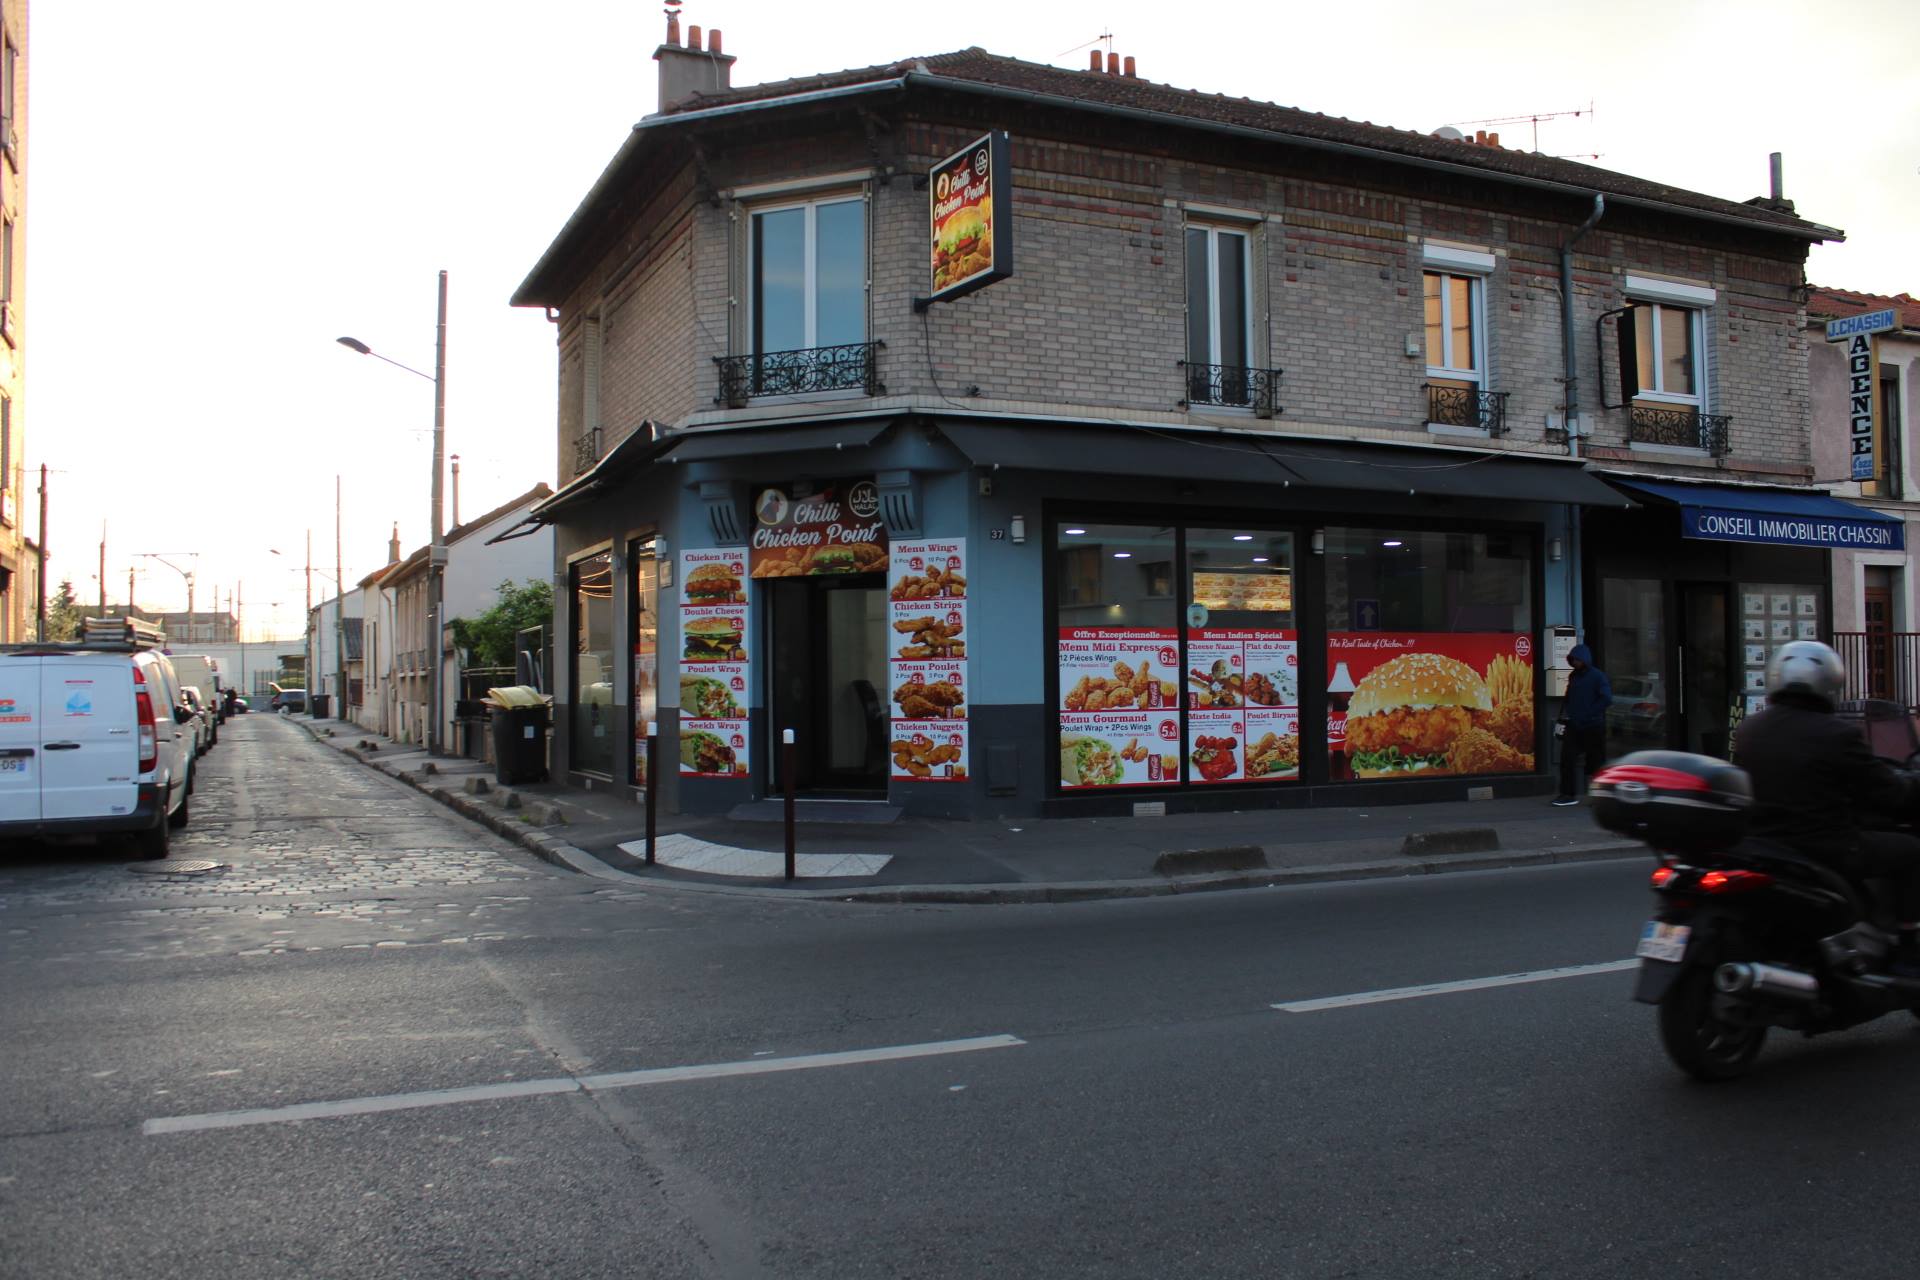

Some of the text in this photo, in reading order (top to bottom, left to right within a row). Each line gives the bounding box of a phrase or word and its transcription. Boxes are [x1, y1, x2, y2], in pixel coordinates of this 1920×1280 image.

[951, 168, 971, 194] Chilli
[934, 175, 989, 221] Chicken Point
[1827, 311, 1895, 337] J.CHASSIN
[1850, 335, 1872, 456] AGENCE
[794, 501, 841, 525] Chilli
[991, 529, 1004, 540] 37
[1698, 514, 1892, 545] CONSEIL IMMOBILIER CHASSIN
[753, 522, 884, 550] Chicken Point
[897, 543, 959, 554] Menu Wings
[685, 552, 744, 562] Chicken Filet
[684, 607, 744, 616] Double Cheese
[894, 601, 963, 611] Chicken Strips
[1073, 630, 1097, 640] Offre
[1098, 630, 1161, 641] Exceptionnelle
[1203, 632, 1283, 641] Menu Indien Spécial
[1059, 642, 1161, 654] Menu Midi Express
[1273, 643, 1291, 651] Jour
[1329, 638, 1342, 648] The
[1341, 638, 1355, 648] Real
[1355, 638, 1372, 648] Taste
[1372, 638, 1381, 650] of
[1059, 654, 1068, 662] 12
[1095, 653, 1118, 664] Wings
[687, 664, 742, 675] Poulet Wrap
[927, 662, 961, 672] Poulet
[1060, 713, 1147, 724] Menu Gourmand
[1247, 712, 1270, 720] Poulet
[687, 721, 742, 732] Seekh Wrap
[895, 722, 965, 733] Chicken Nuggets
[1084, 724, 1104, 733] Wrap
[1129, 723, 1153, 734] Wings
